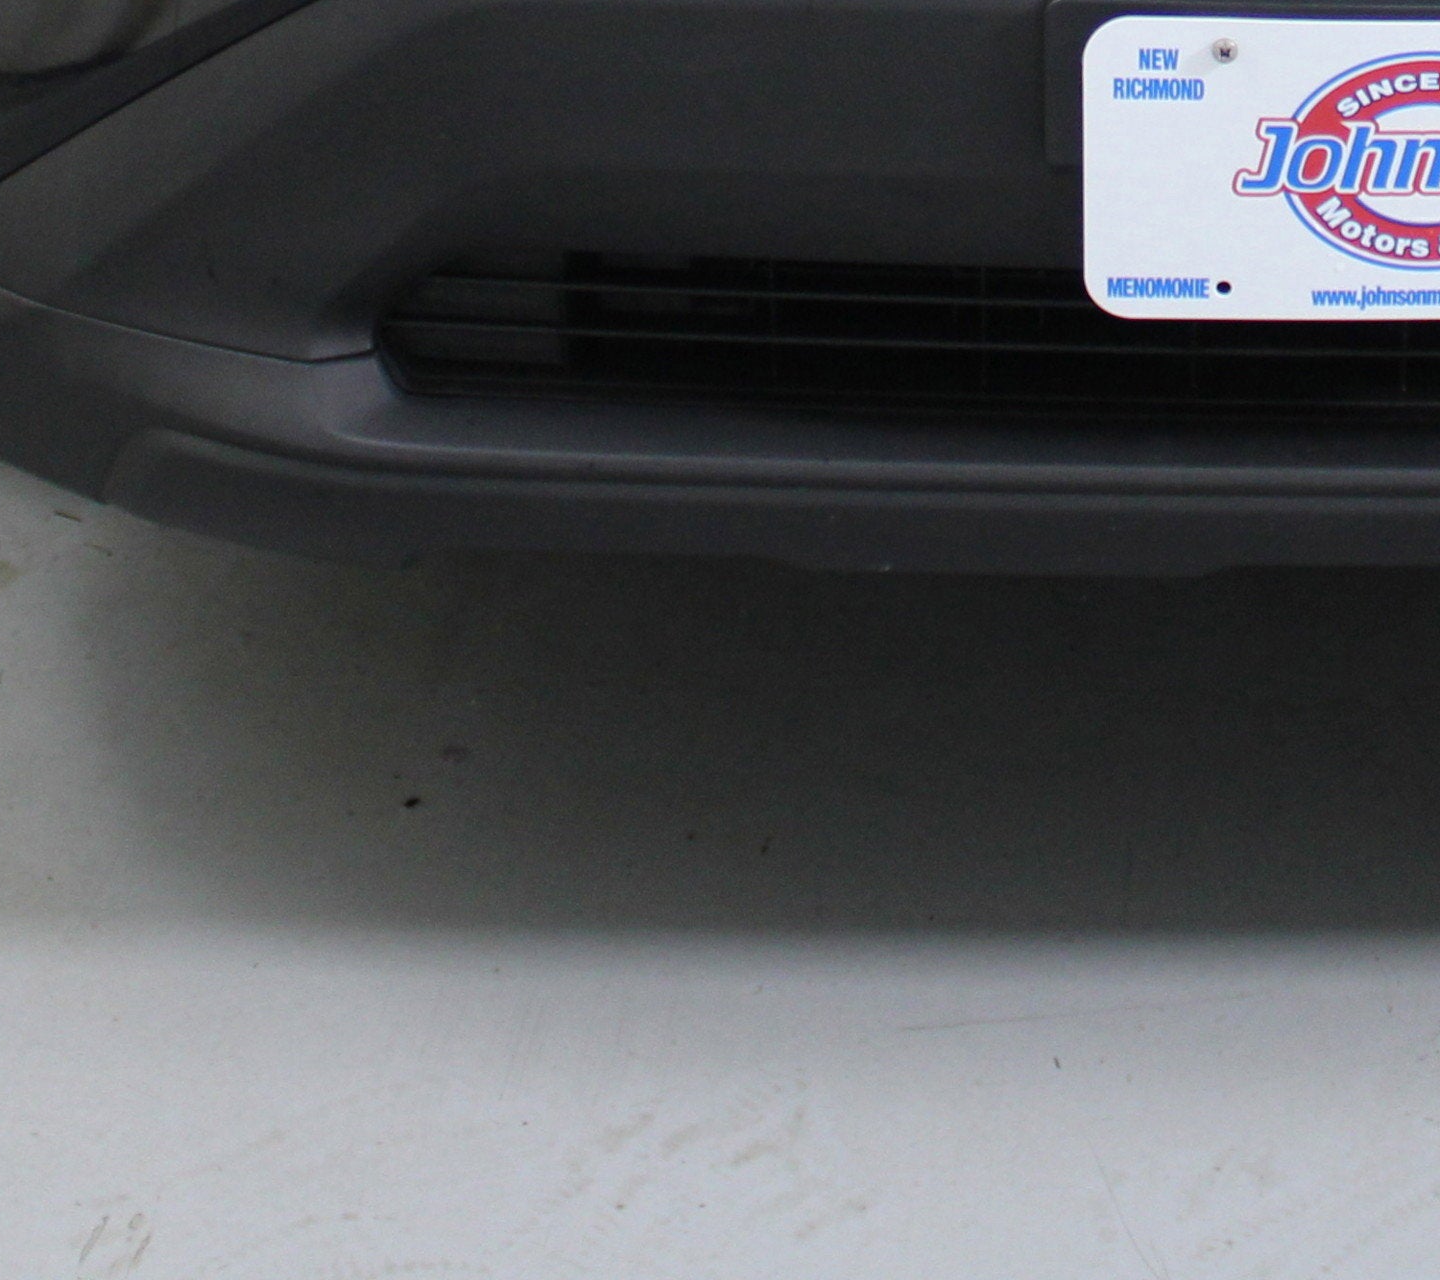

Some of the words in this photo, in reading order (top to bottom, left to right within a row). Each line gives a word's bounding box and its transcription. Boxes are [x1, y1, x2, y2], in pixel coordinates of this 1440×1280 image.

[1138, 48, 1179, 70] NEW
[1113, 77, 1205, 100] RICHMOND
[1336, 72, 1440, 119] SINCE
[1315, 195, 1430, 258] Motors
[1107, 277, 1210, 299] MENOMONIE
